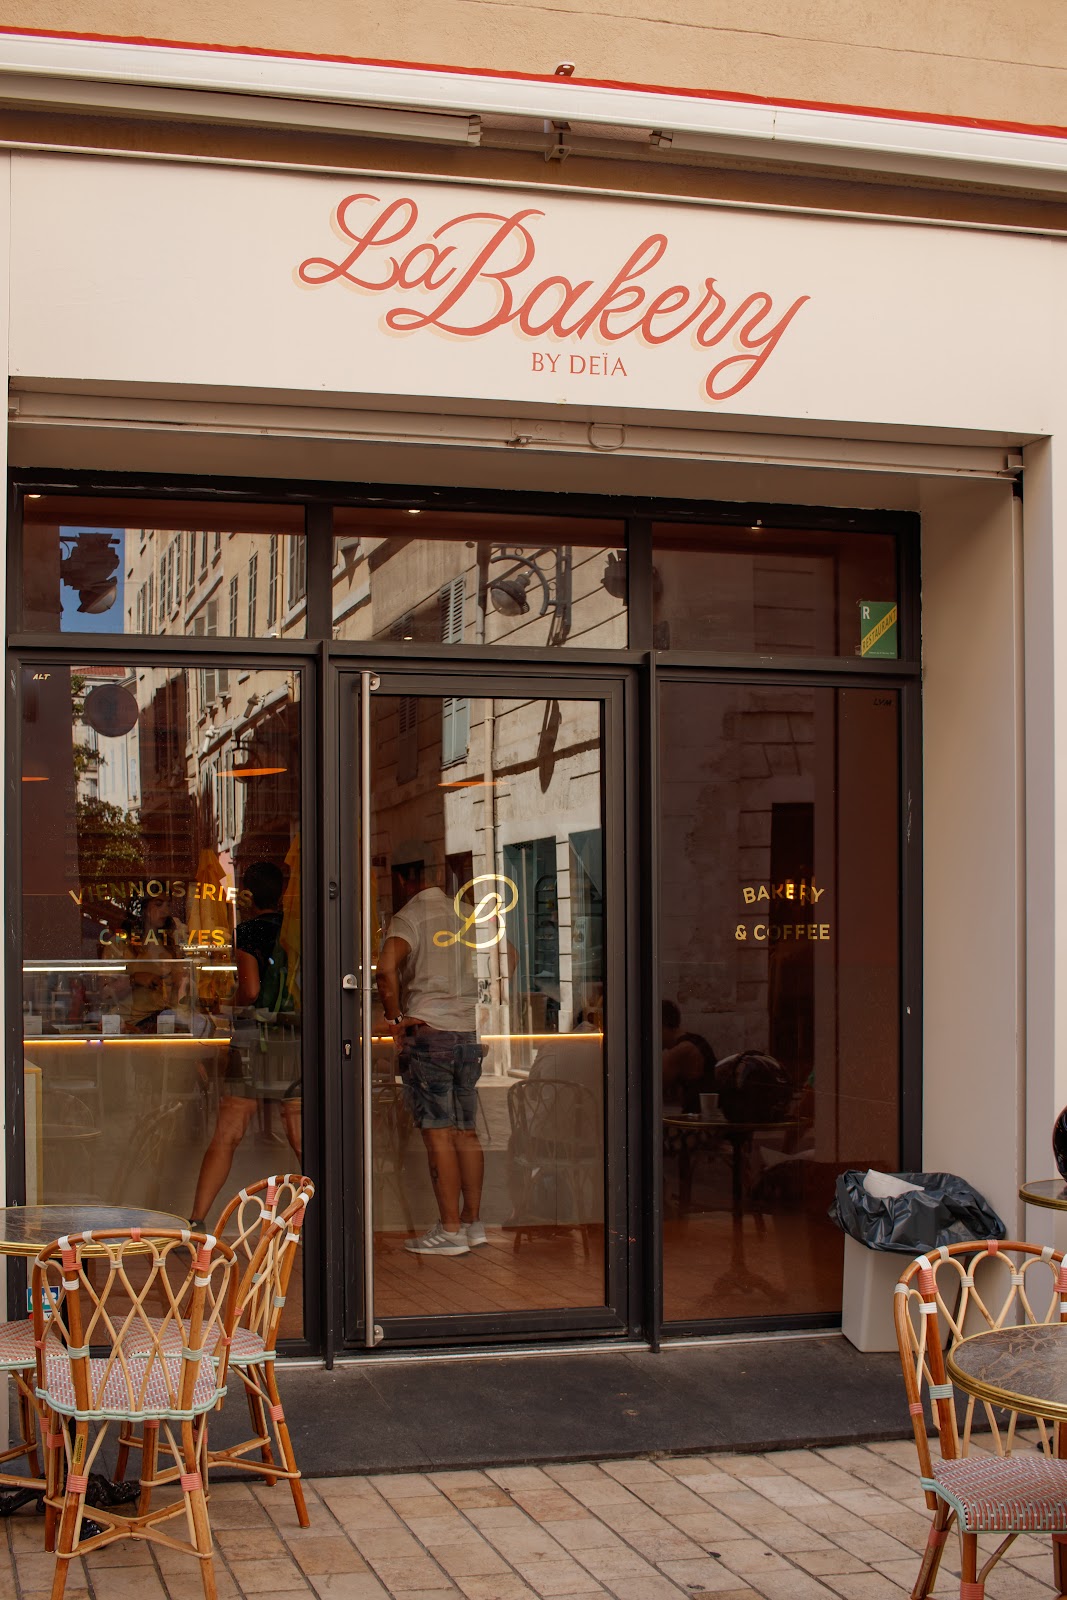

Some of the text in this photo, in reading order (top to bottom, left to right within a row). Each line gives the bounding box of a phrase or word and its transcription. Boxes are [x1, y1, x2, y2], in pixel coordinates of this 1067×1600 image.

[385, 207, 812, 401] Bakery
[531, 351, 628, 377] BY DEÏA
[862, 605, 871, 620] R
[863, 610, 896, 650] RESTAURANT
[68, 879, 253, 907] VIENNOISERIES
[742, 883, 825, 904] BAKERY
[734, 923, 830, 941] & COFFEE
